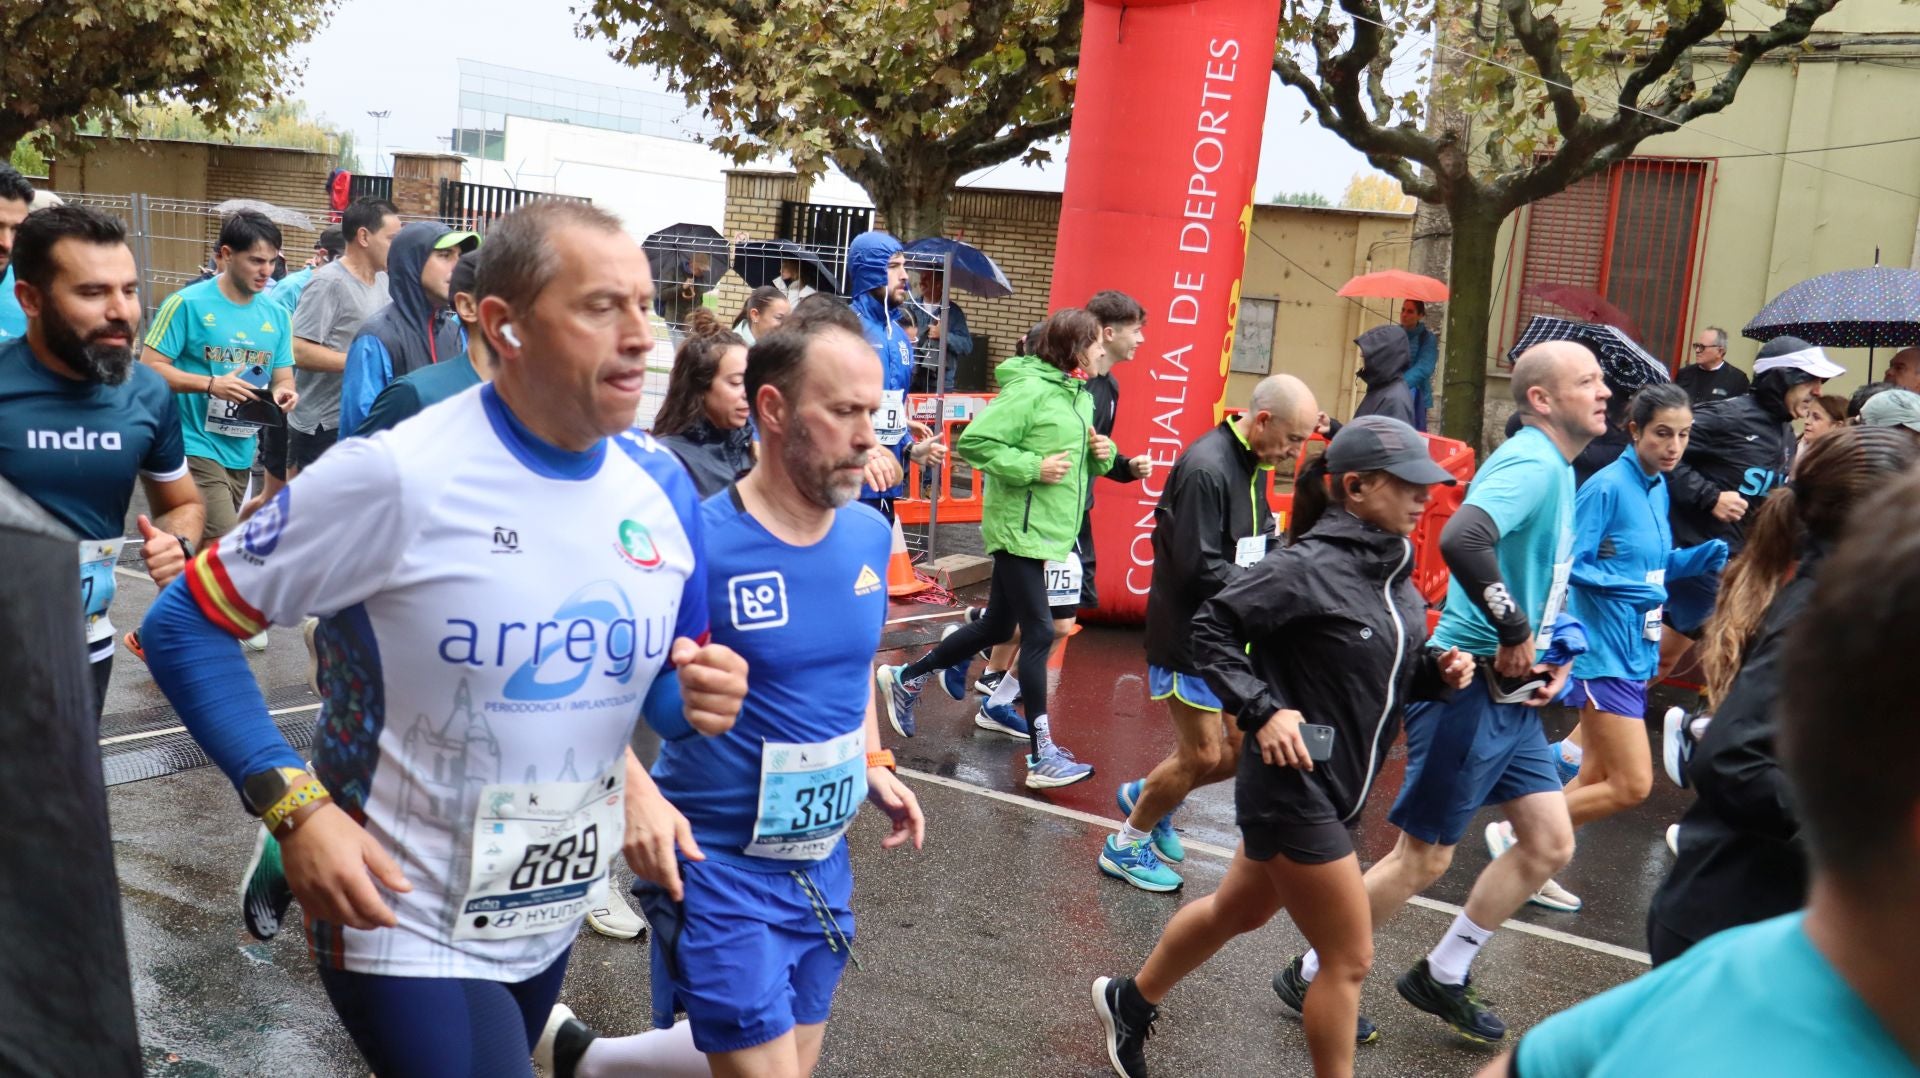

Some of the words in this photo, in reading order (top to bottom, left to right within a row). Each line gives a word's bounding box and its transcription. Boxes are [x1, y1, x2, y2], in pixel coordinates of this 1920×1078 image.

[1179, 38, 1240, 253] DEPORTES
[1167, 271, 1205, 325] DE
[27, 426, 122, 451] indra
[438, 600, 675, 677] arregui
[484, 701, 560, 713] PERIODONCIA
[528, 793, 539, 807] k
[791, 775, 854, 831] 330
[510, 823, 598, 891] 689
[525, 899, 591, 923] HYUND
